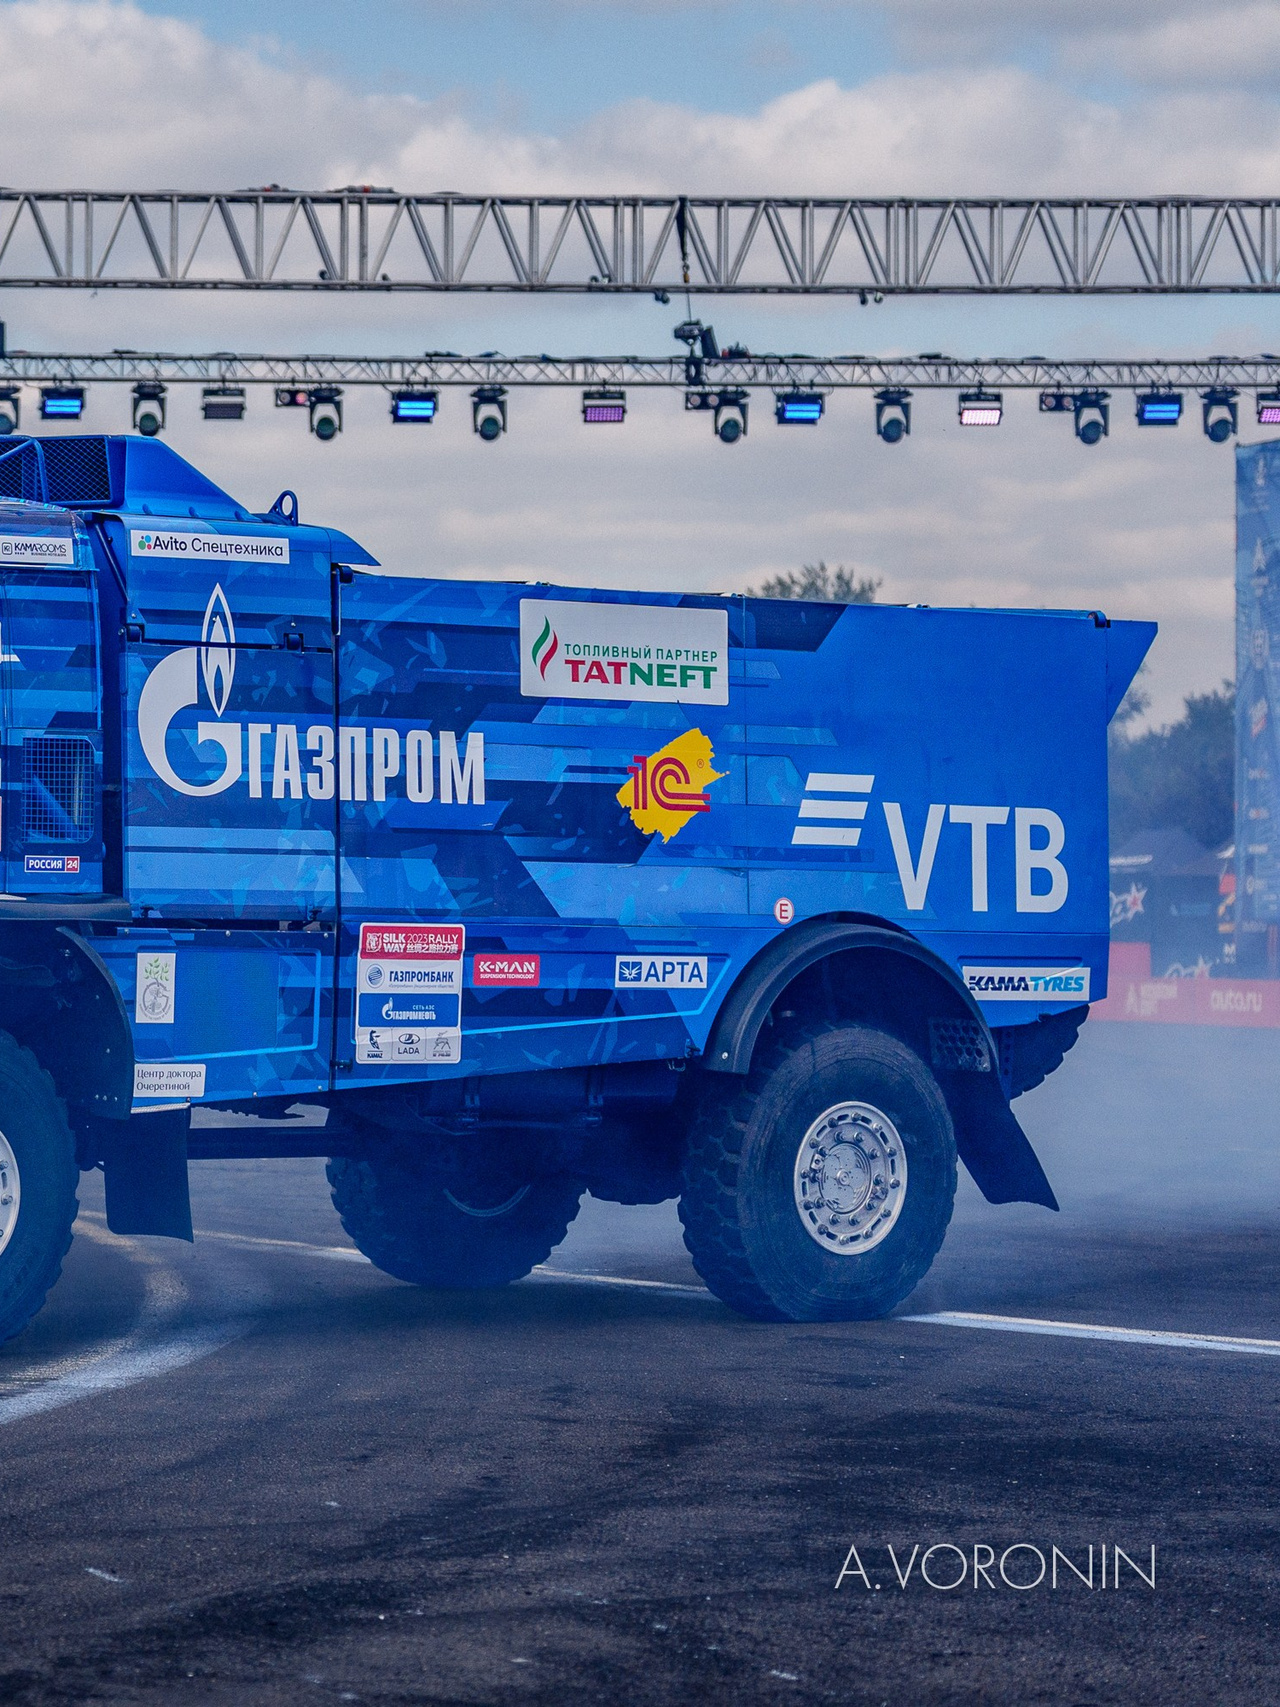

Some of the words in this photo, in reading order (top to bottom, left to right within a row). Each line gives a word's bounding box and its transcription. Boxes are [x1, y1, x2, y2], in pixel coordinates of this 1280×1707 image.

[14, 542, 67, 554] KAMAROOMS
[152, 536, 188, 552] Avito
[190, 538, 284, 557] Спецтехника
[564, 643, 652, 660] ТОПЛИВНЫЙ
[656, 648, 718, 662] ПАРТНЕР
[564, 659, 718, 689] TATNEFT
[247, 723, 486, 805] ГАЗПРОМ
[28, 859, 63, 869] РОССИЯ
[66, 858, 79, 870] 24
[882, 802, 1070, 913] VTB
[778, 903, 789, 919] E
[383, 933, 406, 943] SILK
[407, 933, 428, 943] 2023
[428, 934, 459, 944] RALLY
[383, 943, 405, 953] WAY
[478, 961, 536, 973] K-MAN
[389, 970, 454, 983] ГАЗПРОМБАНК
[398, 1047, 420, 1055] LADA
[137, 1068, 165, 1081] Центр
[166, 1070, 202, 1082] доктора
[136, 1081, 191, 1093] Очеретиной
